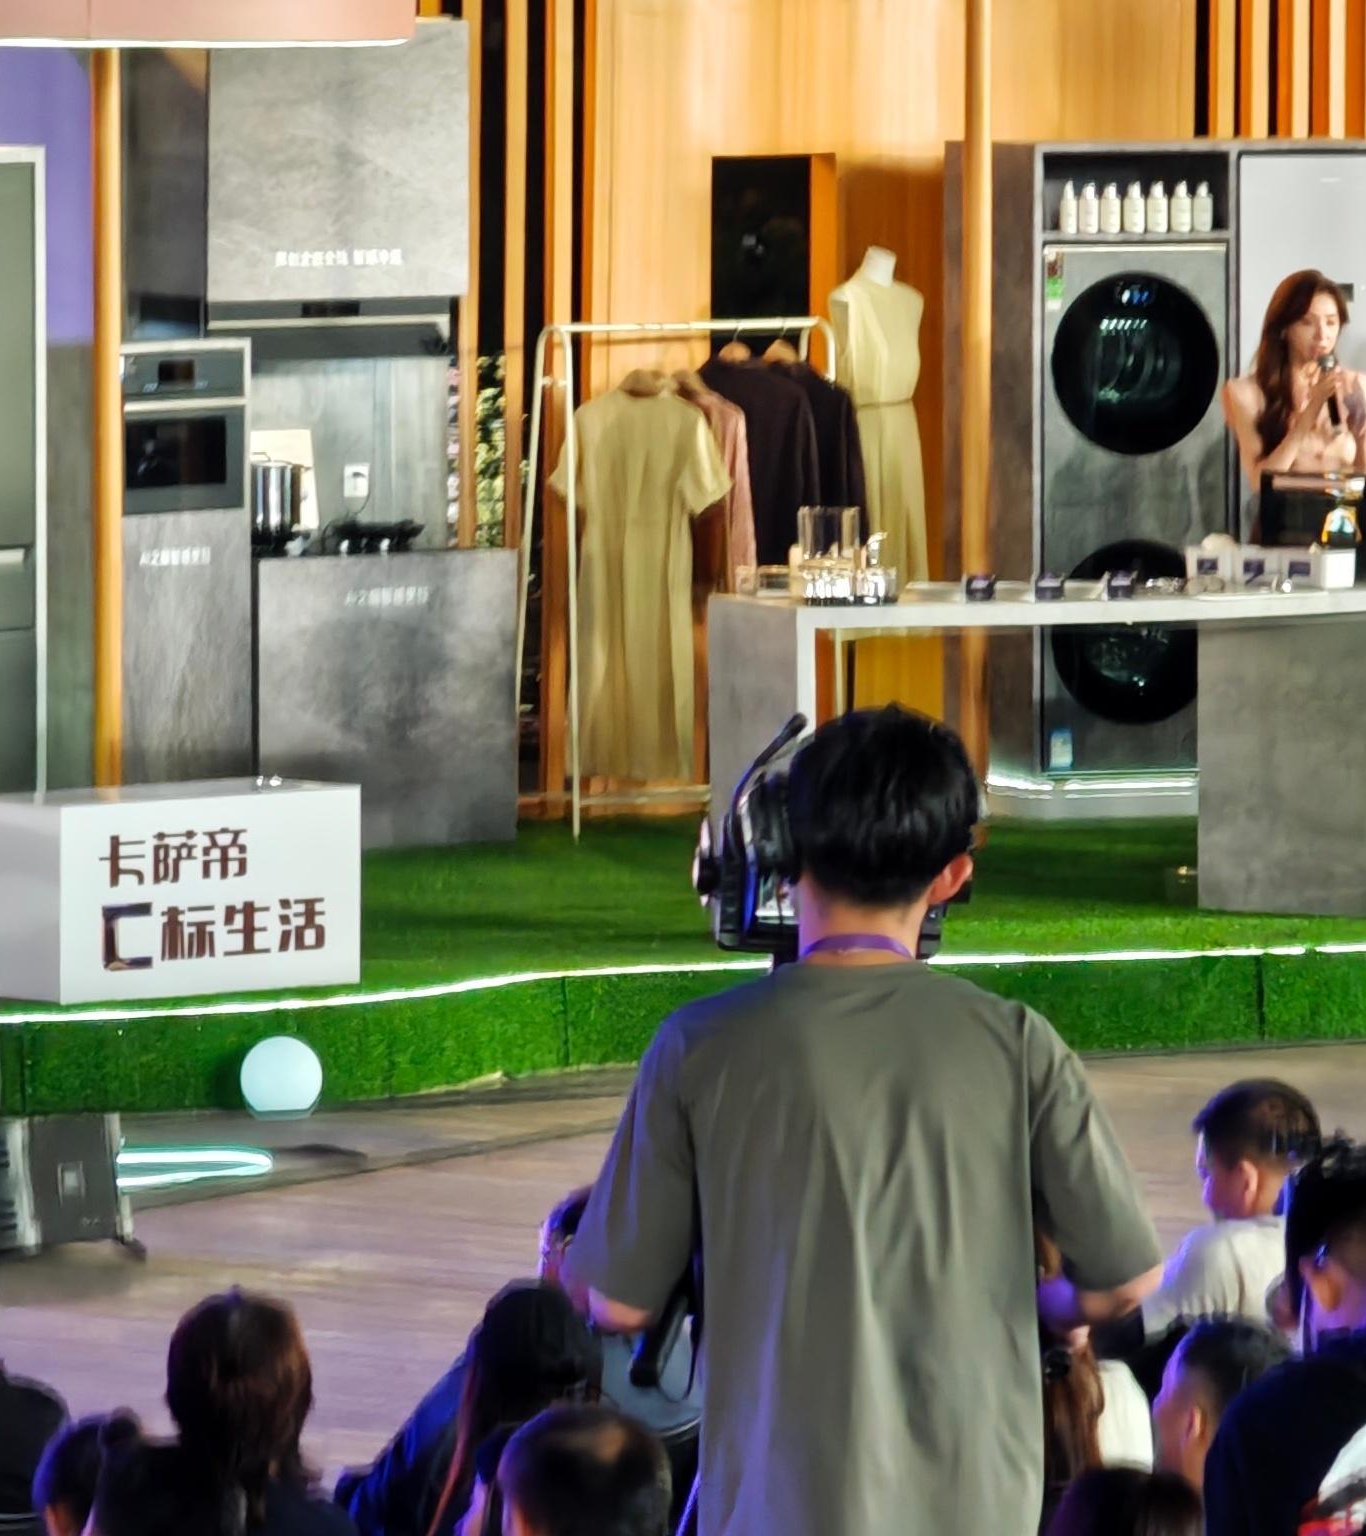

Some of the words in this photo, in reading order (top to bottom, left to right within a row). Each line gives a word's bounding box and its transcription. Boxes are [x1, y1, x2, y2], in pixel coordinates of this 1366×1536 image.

[99, 826, 248, 888] 卡萨帝
[101, 897, 326, 972] C标生活
